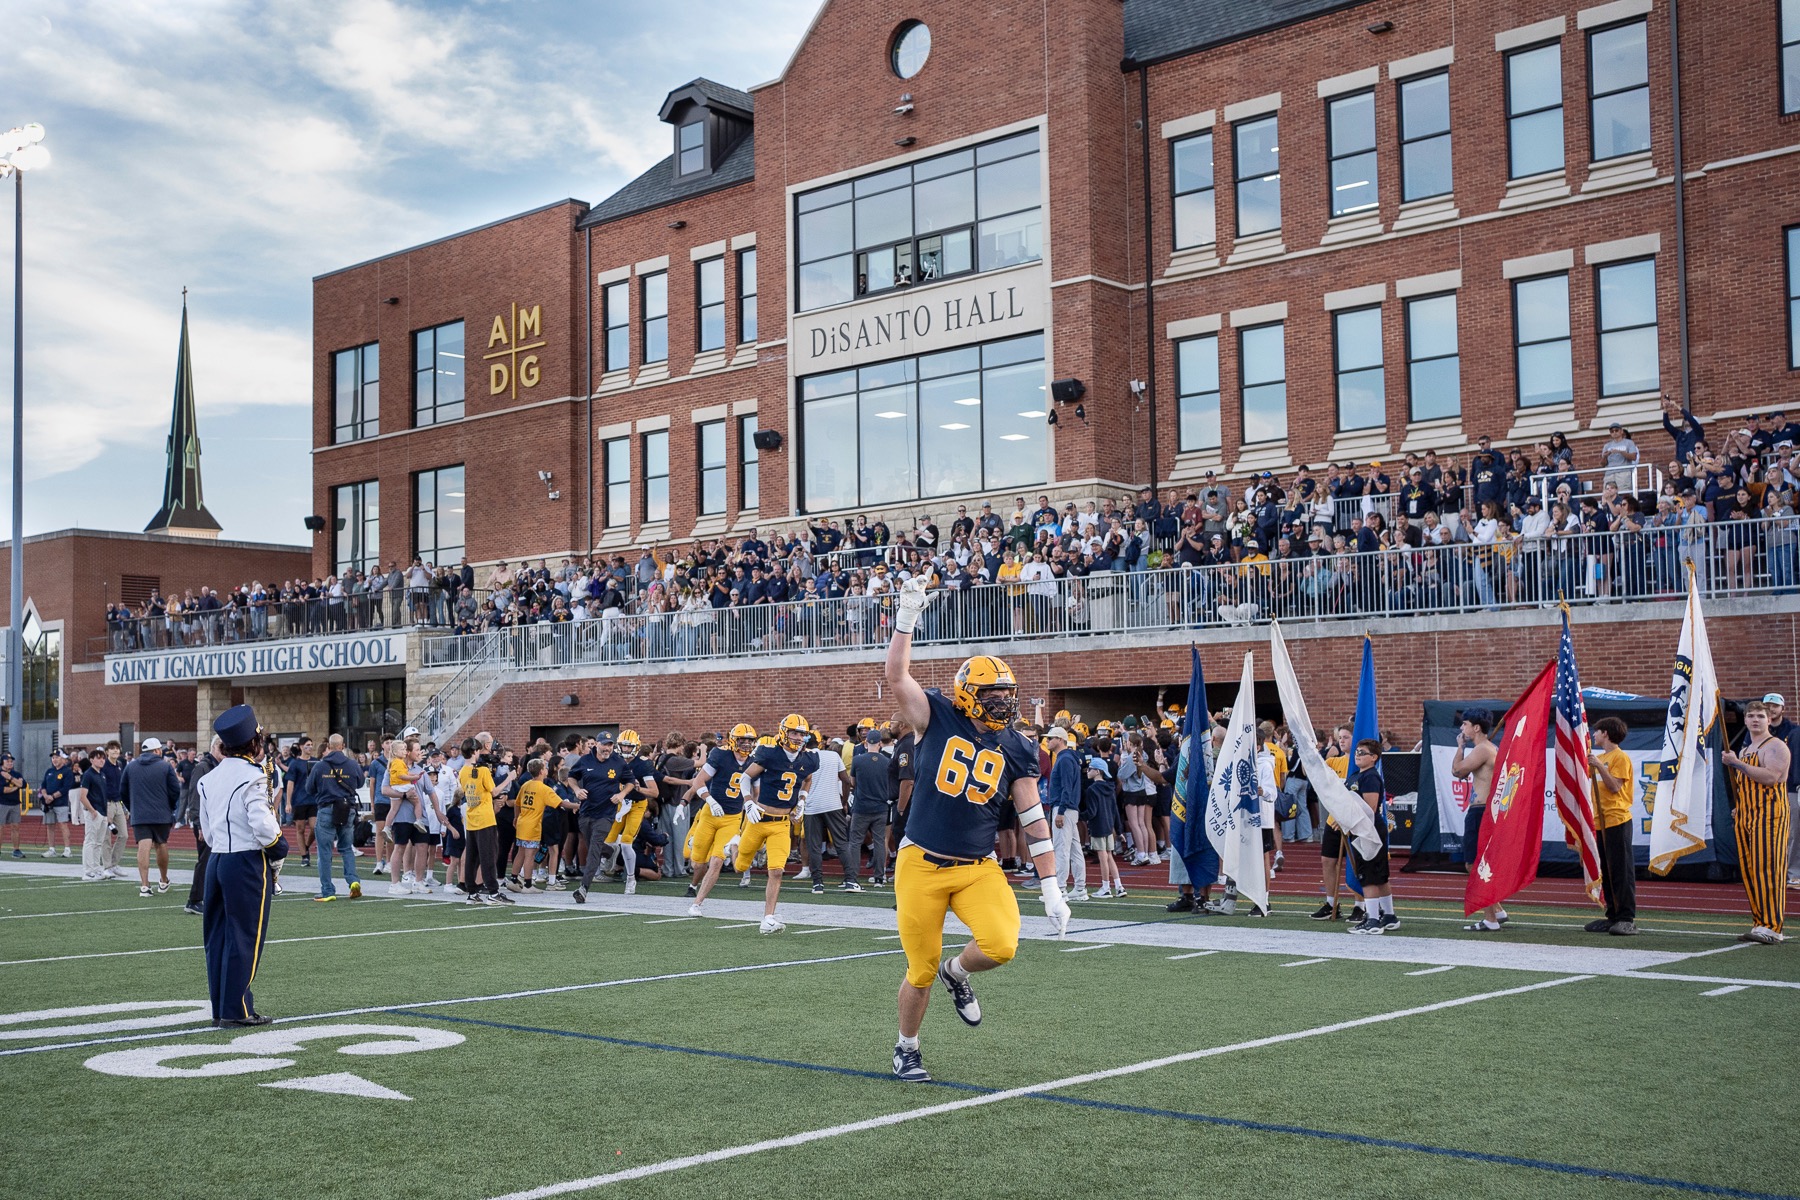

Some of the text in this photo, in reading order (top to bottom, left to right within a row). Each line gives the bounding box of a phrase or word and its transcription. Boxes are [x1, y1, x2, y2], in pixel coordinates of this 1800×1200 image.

[810, 287, 1024, 359] DiSANTO HALL
[111, 638, 398, 683] SAINT IGNATIUS HIGH SCHOOL
[777, 771, 797, 801] 3
[935, 735, 1005, 805] 69
[523, 795, 534, 806] 26
[1208, 816, 1225, 837] 1790
